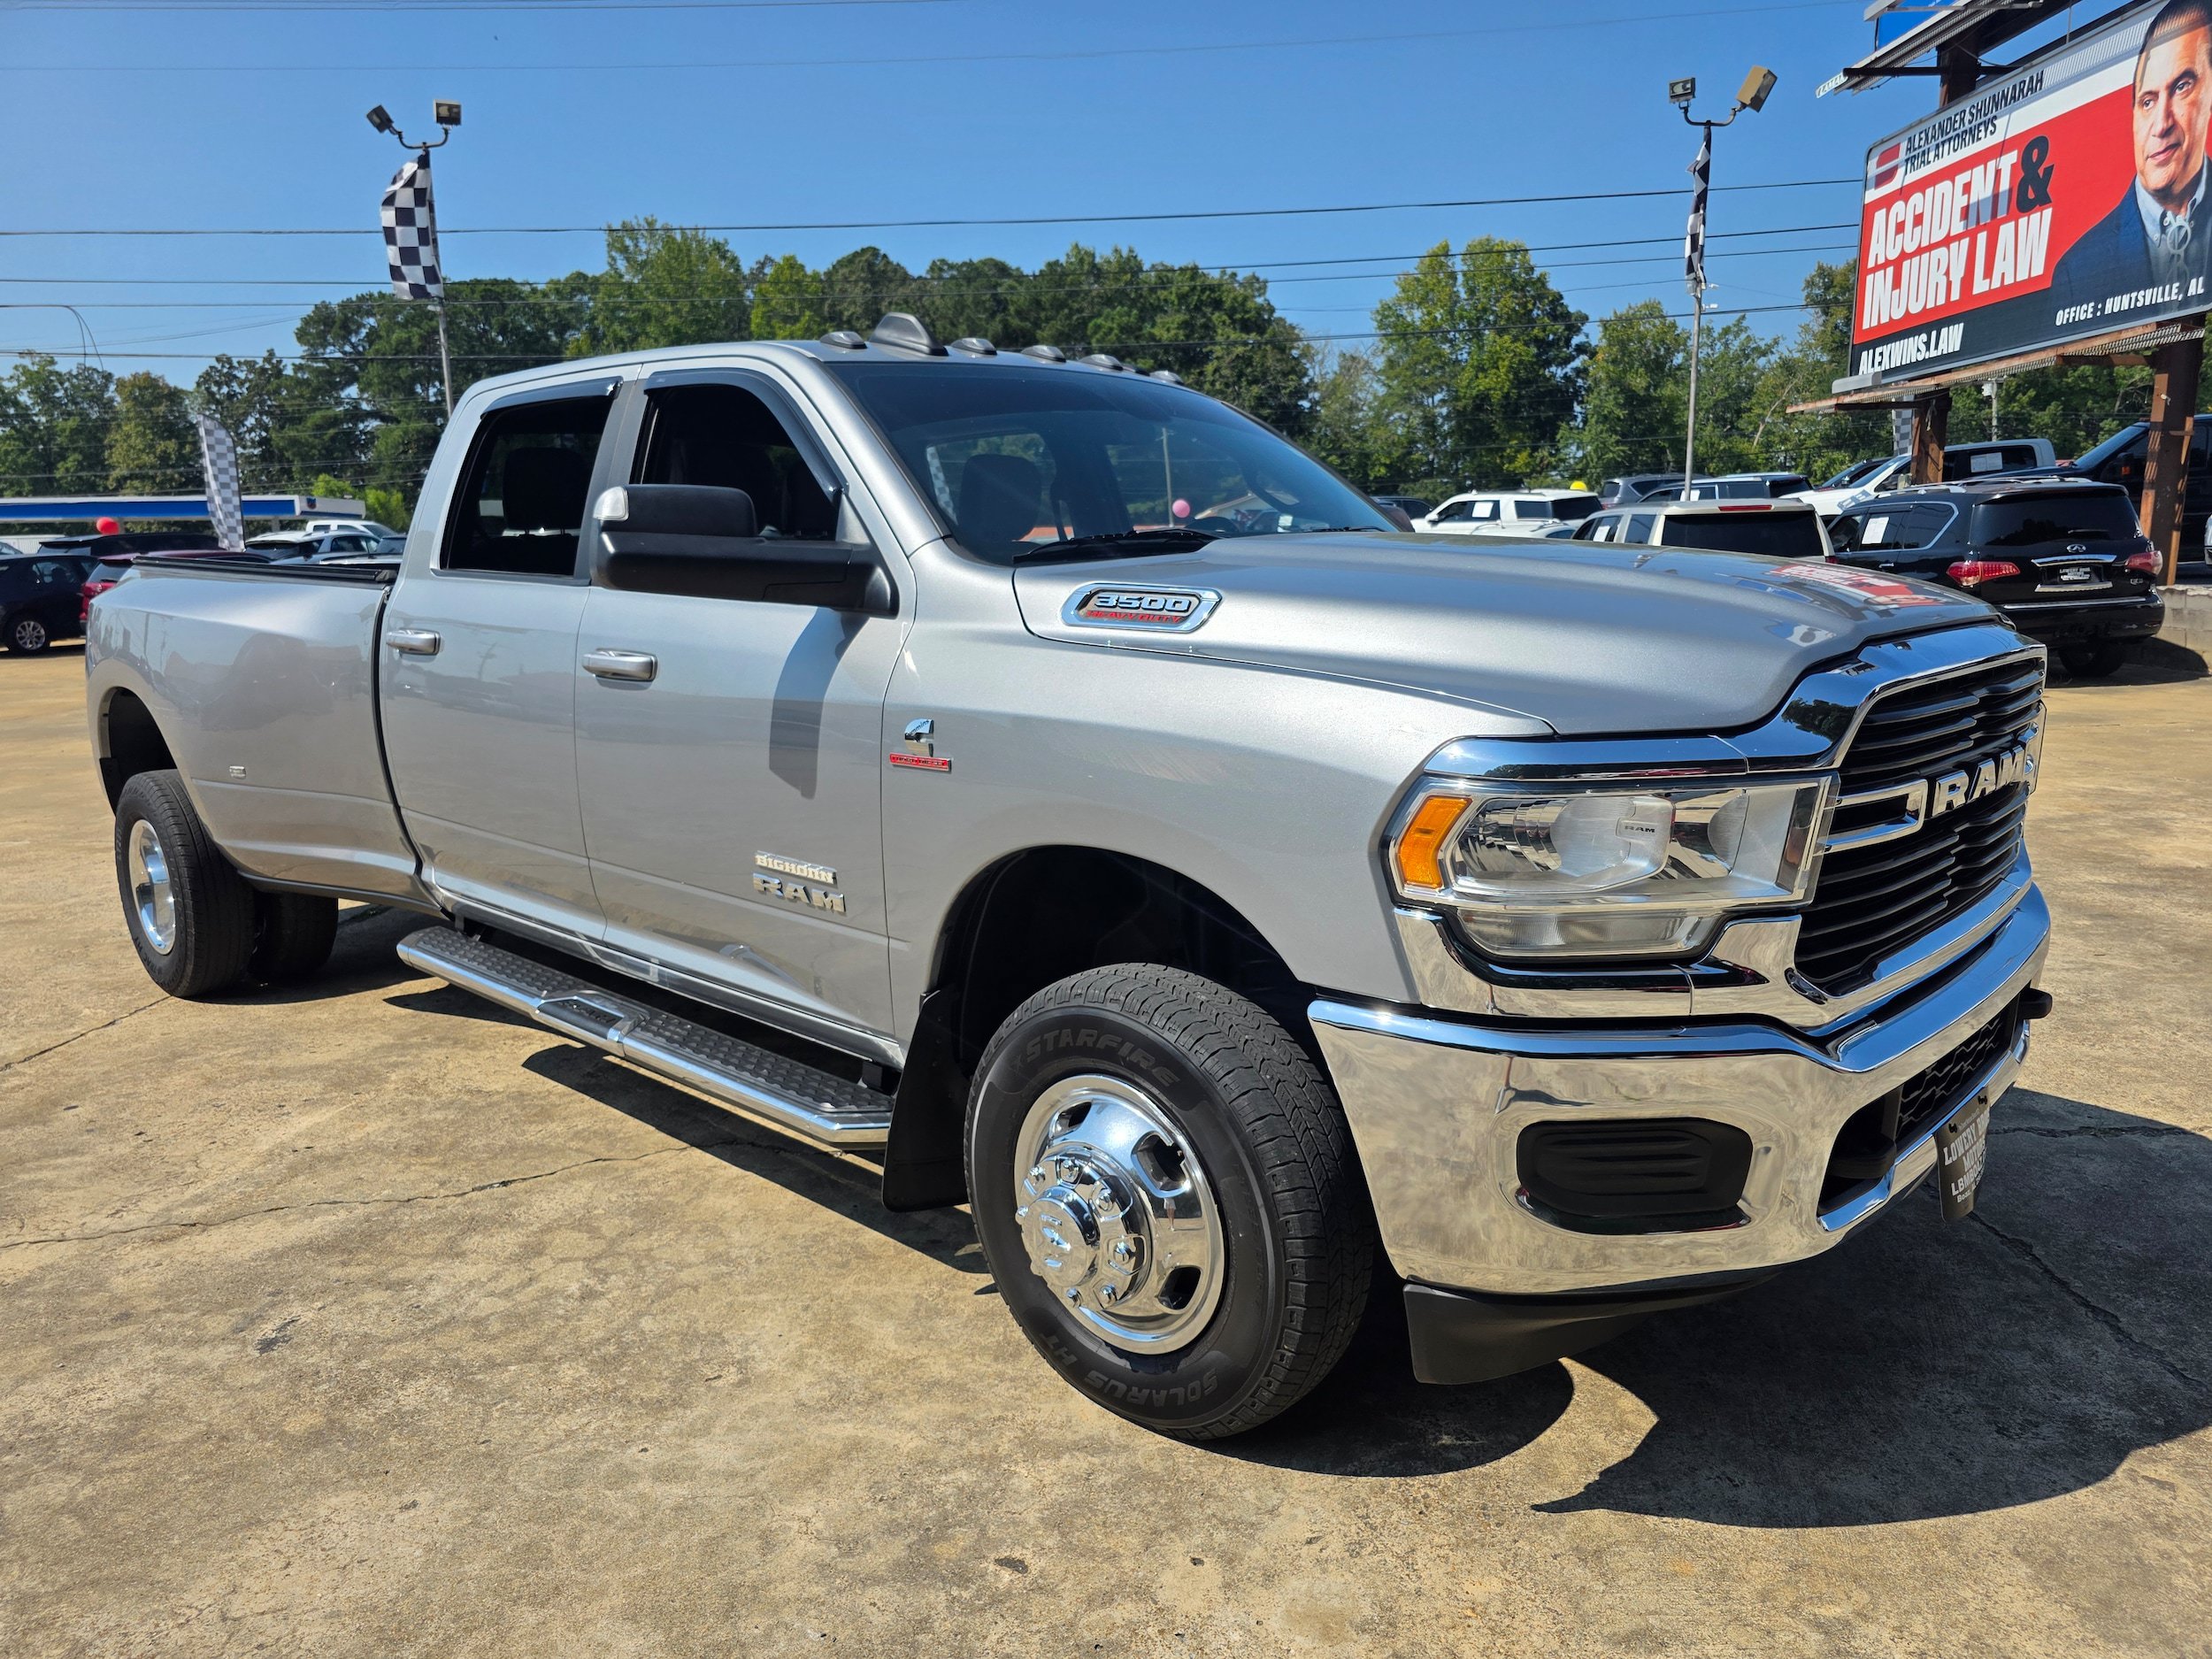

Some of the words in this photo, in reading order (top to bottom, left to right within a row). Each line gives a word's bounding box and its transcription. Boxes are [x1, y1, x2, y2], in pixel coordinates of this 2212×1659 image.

[1905, 109, 1967, 157] ALEXANDER
[1968, 70, 2045, 126] SHUNNARAH
[1904, 147, 1932, 177] TRIAL
[1932, 115, 1998, 163] ATTORNEYS
[1867, 149, 2018, 270] ACCIDENT
[2016, 135, 2055, 213] &
[1862, 237, 1970, 330] INJURY
[1972, 207, 2054, 296] LAW
[2055, 301, 2095, 326] OFFICE
[2104, 281, 2184, 315] HUNTSVILLE,
[2187, 275, 2205, 297] AL
[1858, 322, 1964, 376] ALEXWINS.LAW
[1086, 610, 1138, 620] HEAVY
[1138, 613, 1184, 624] DUTY
[1094, 594, 1192, 612] 3500
[1932, 745, 2025, 817] RAM
[753, 872, 847, 912] RAM
[754, 851, 837, 886] BIGHORN
[1025, 1028, 1181, 1087] STARFIRE
[1943, 1123, 1977, 1166] LOWERY
[1039, 1333, 1079, 1367] HT
[1084, 1367, 1218, 1407] SOLARUS
